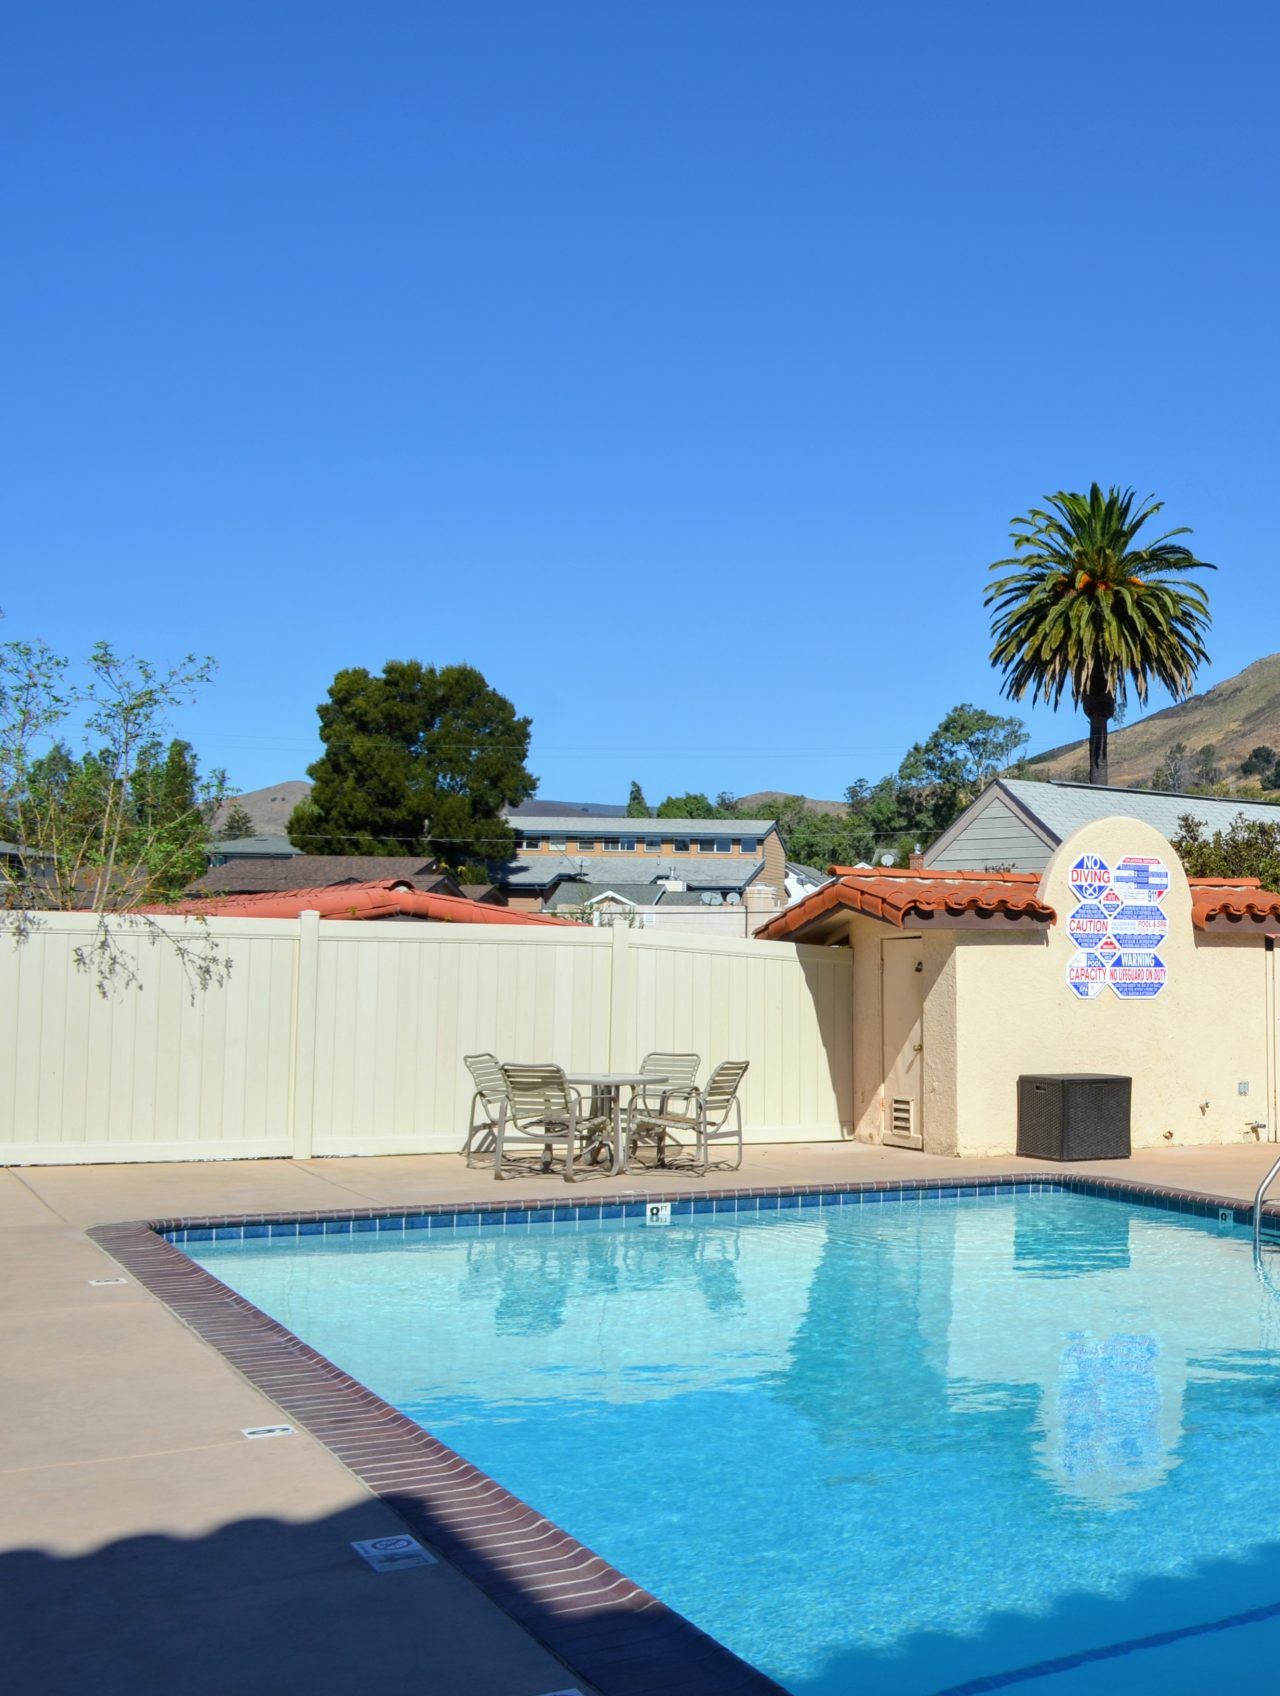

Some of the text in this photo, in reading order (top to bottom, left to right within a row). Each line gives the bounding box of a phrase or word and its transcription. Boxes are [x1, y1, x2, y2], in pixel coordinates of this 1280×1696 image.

[1083, 855, 1101, 869] NO
[1071, 869, 1111, 883] DIVING
[1147, 890, 1158, 902] 911
[1069, 919, 1109, 932] CAUTION
[1138, 920, 1152, 928] POOL
[1121, 953, 1155, 967] WARNING
[1069, 967, 1107, 981] CAPACITY
[1110, 968, 1166, 982] NO LIFEGUARD ON DUTY
